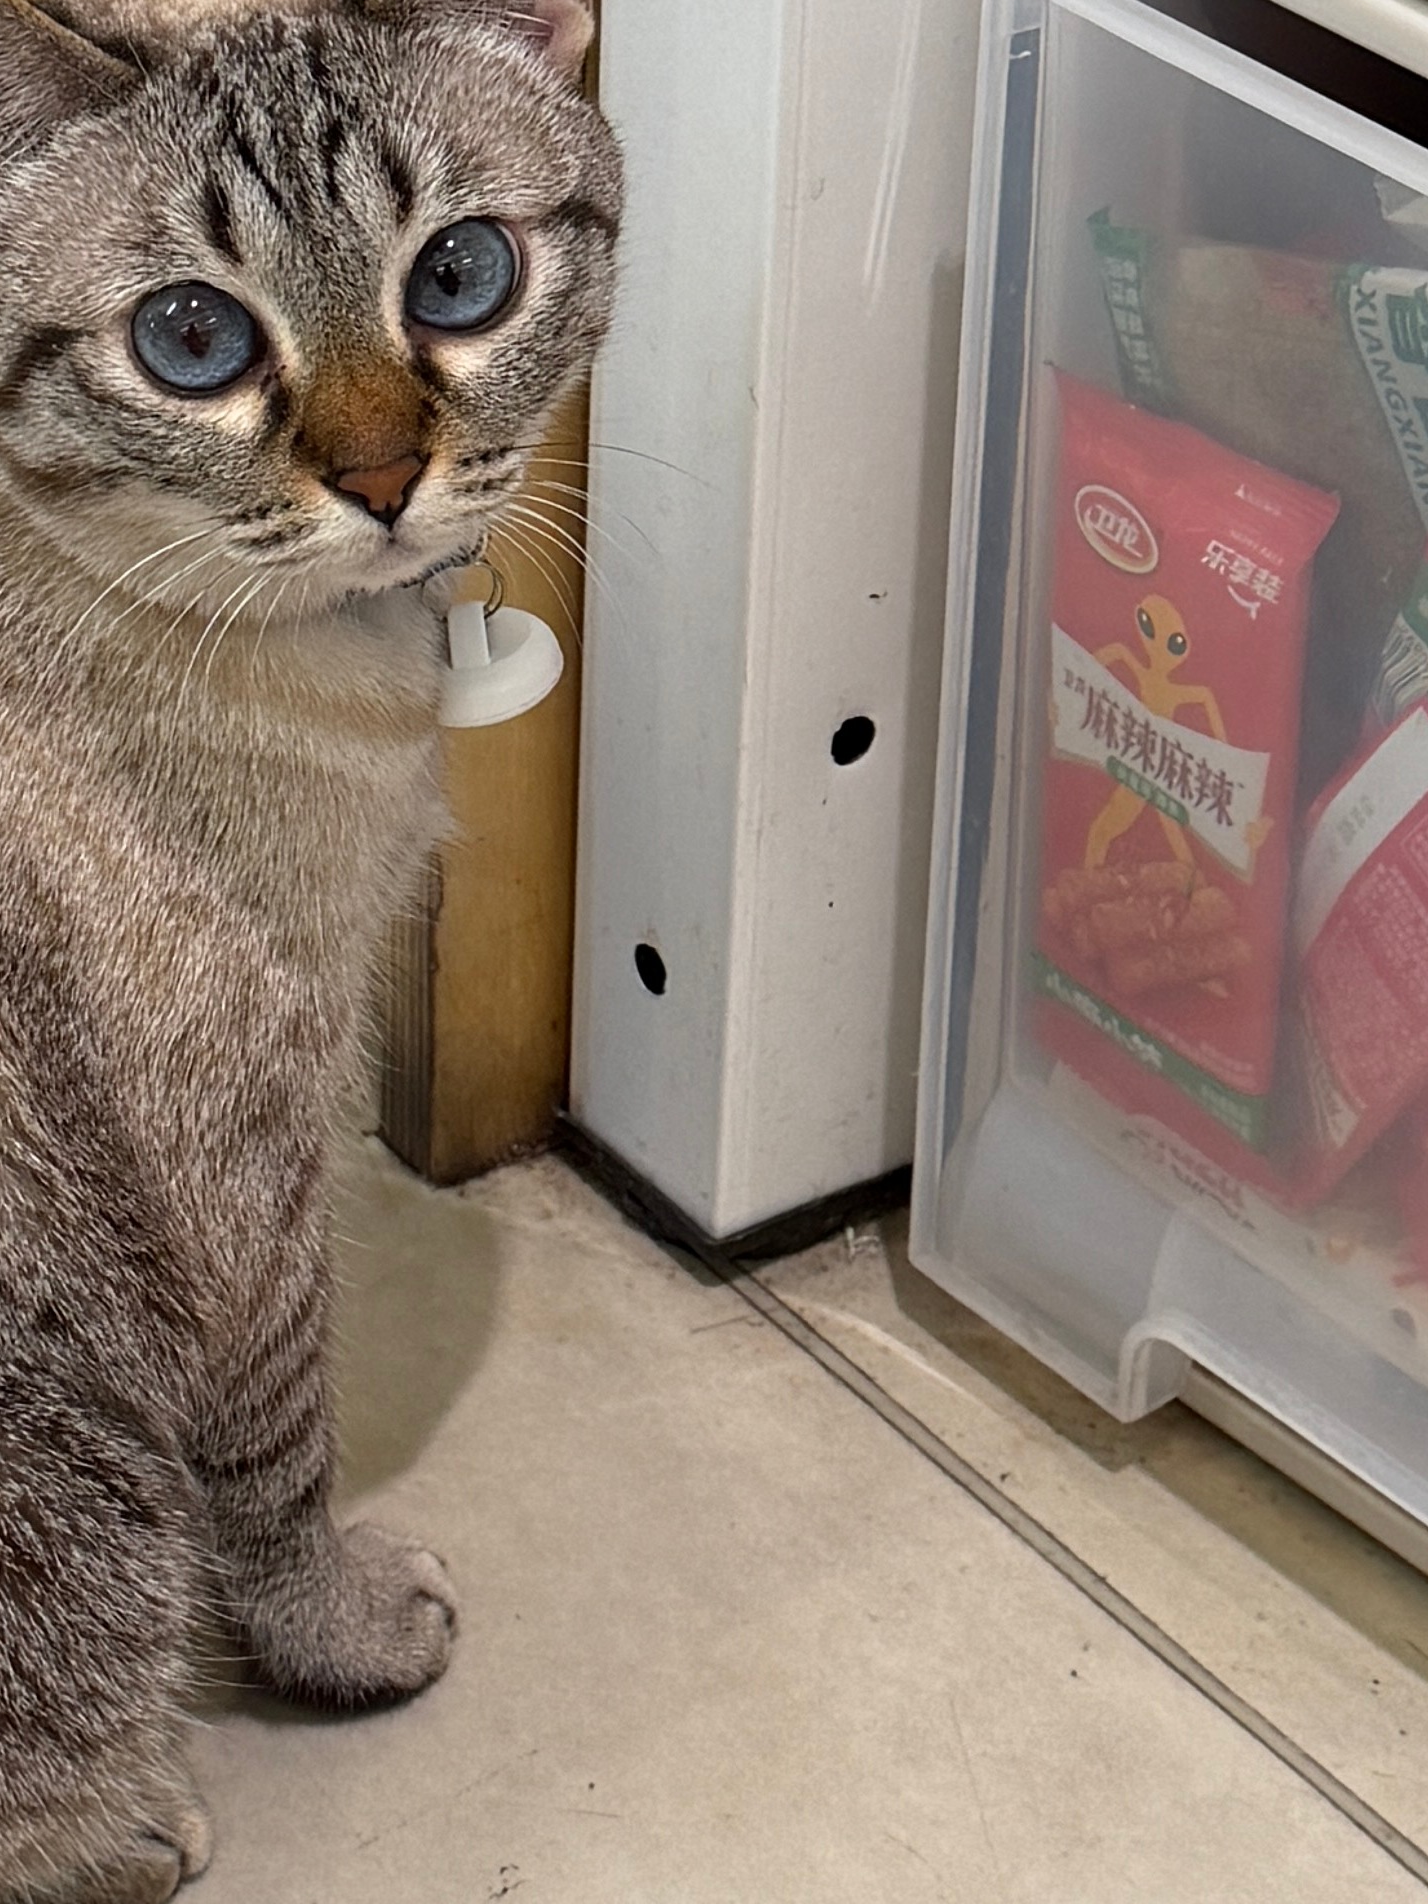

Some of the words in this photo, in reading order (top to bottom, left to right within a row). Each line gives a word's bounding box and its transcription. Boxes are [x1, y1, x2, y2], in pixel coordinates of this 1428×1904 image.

[1200, 537, 1285, 604] 乐享装
[1079, 685, 1236, 828] 麻辣麻辣
